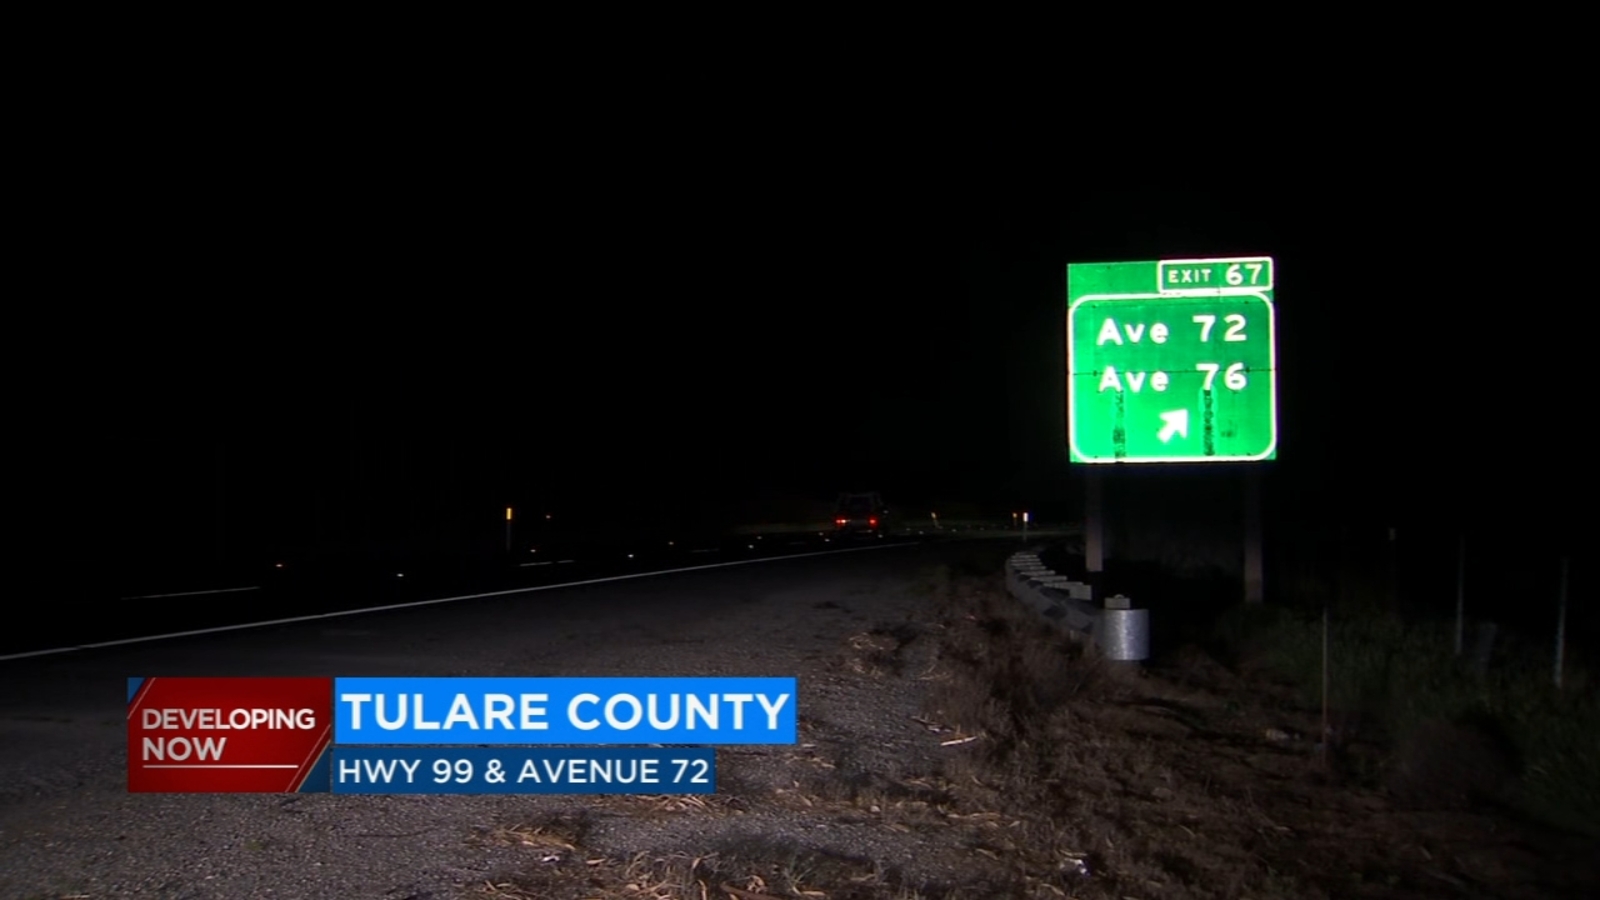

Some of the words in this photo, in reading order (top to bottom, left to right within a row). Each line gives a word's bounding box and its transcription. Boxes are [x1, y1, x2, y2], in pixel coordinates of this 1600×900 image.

[1168, 269, 1212, 283] EXIT
[1225, 264, 1263, 286] 67
[1097, 318, 1168, 346] Ave
[1193, 314, 1246, 342] 72
[1099, 366, 1169, 392] Ave
[1196, 362, 1247, 390] 76
